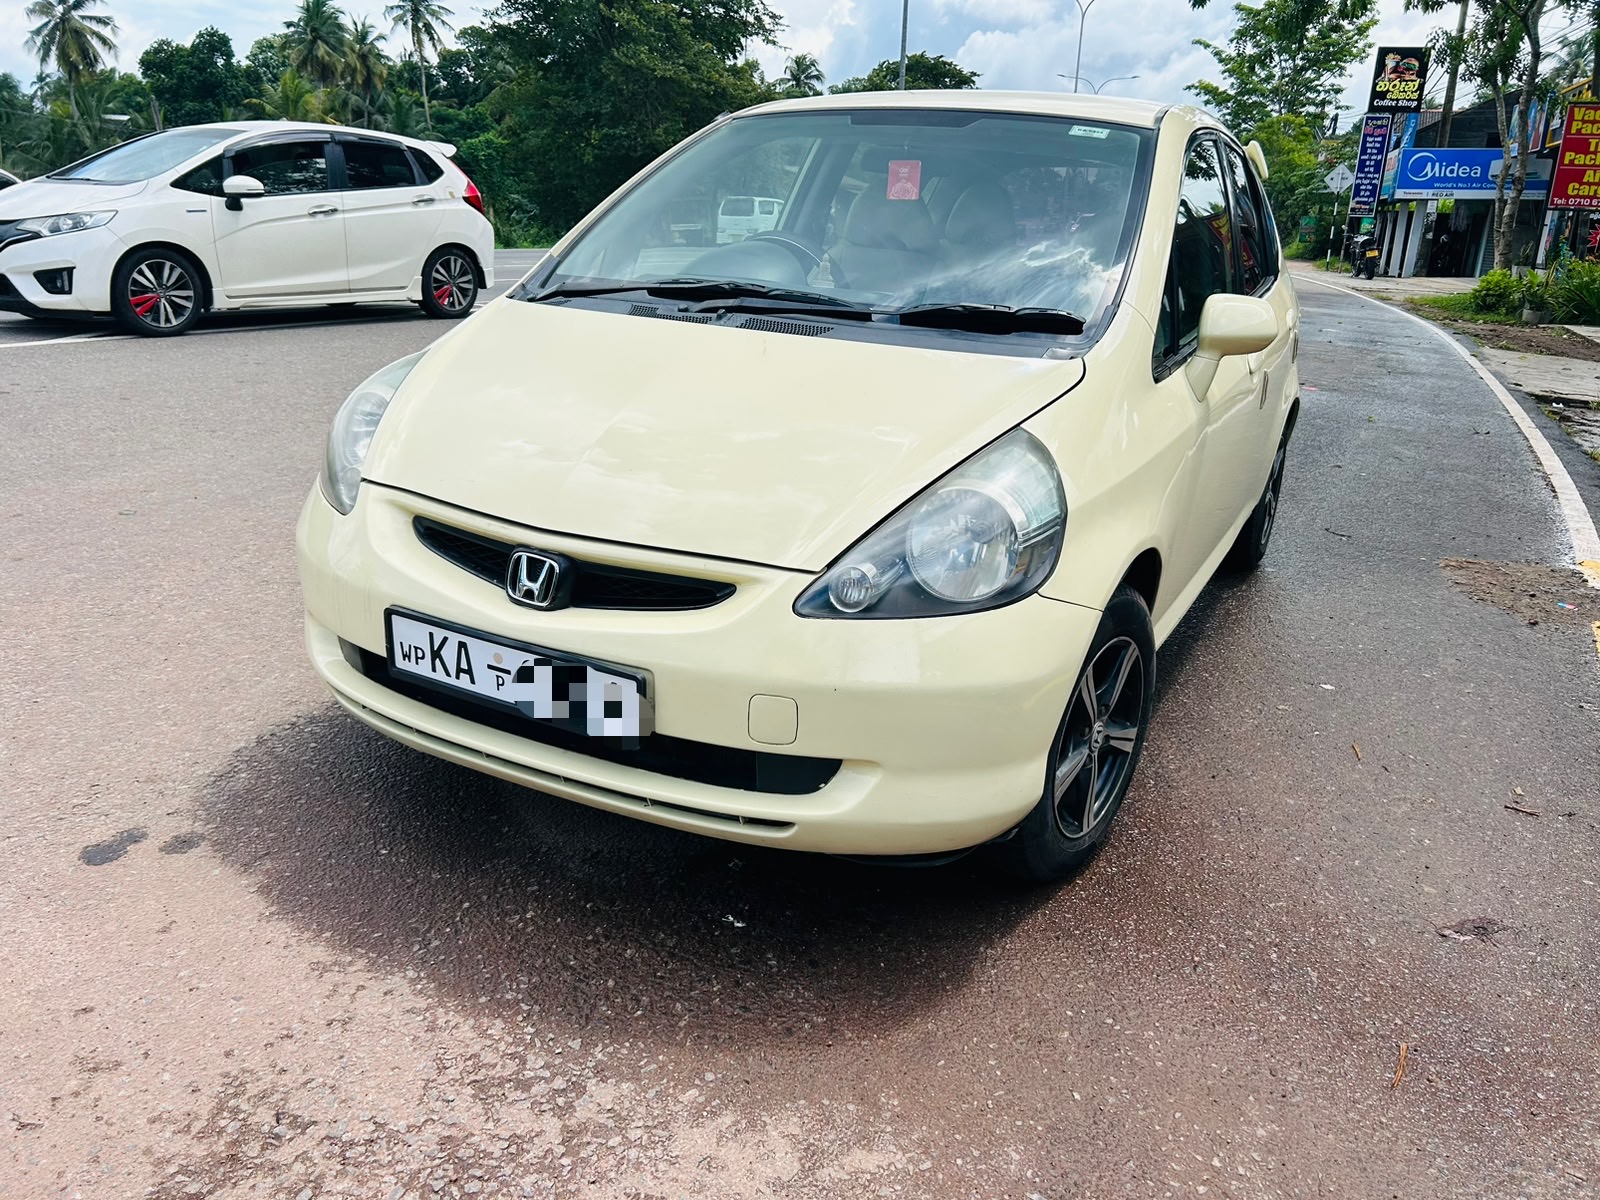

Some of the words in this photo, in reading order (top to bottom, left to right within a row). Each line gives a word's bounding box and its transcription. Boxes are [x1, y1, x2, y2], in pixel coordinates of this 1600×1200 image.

[1397, 99, 1418, 108] Shop
[1417, 160, 1481, 178] Midea
[1553, 197, 1567, 205] Tel:
[400, 641, 426, 666] WP
[428, 631, 476, 686] KA
